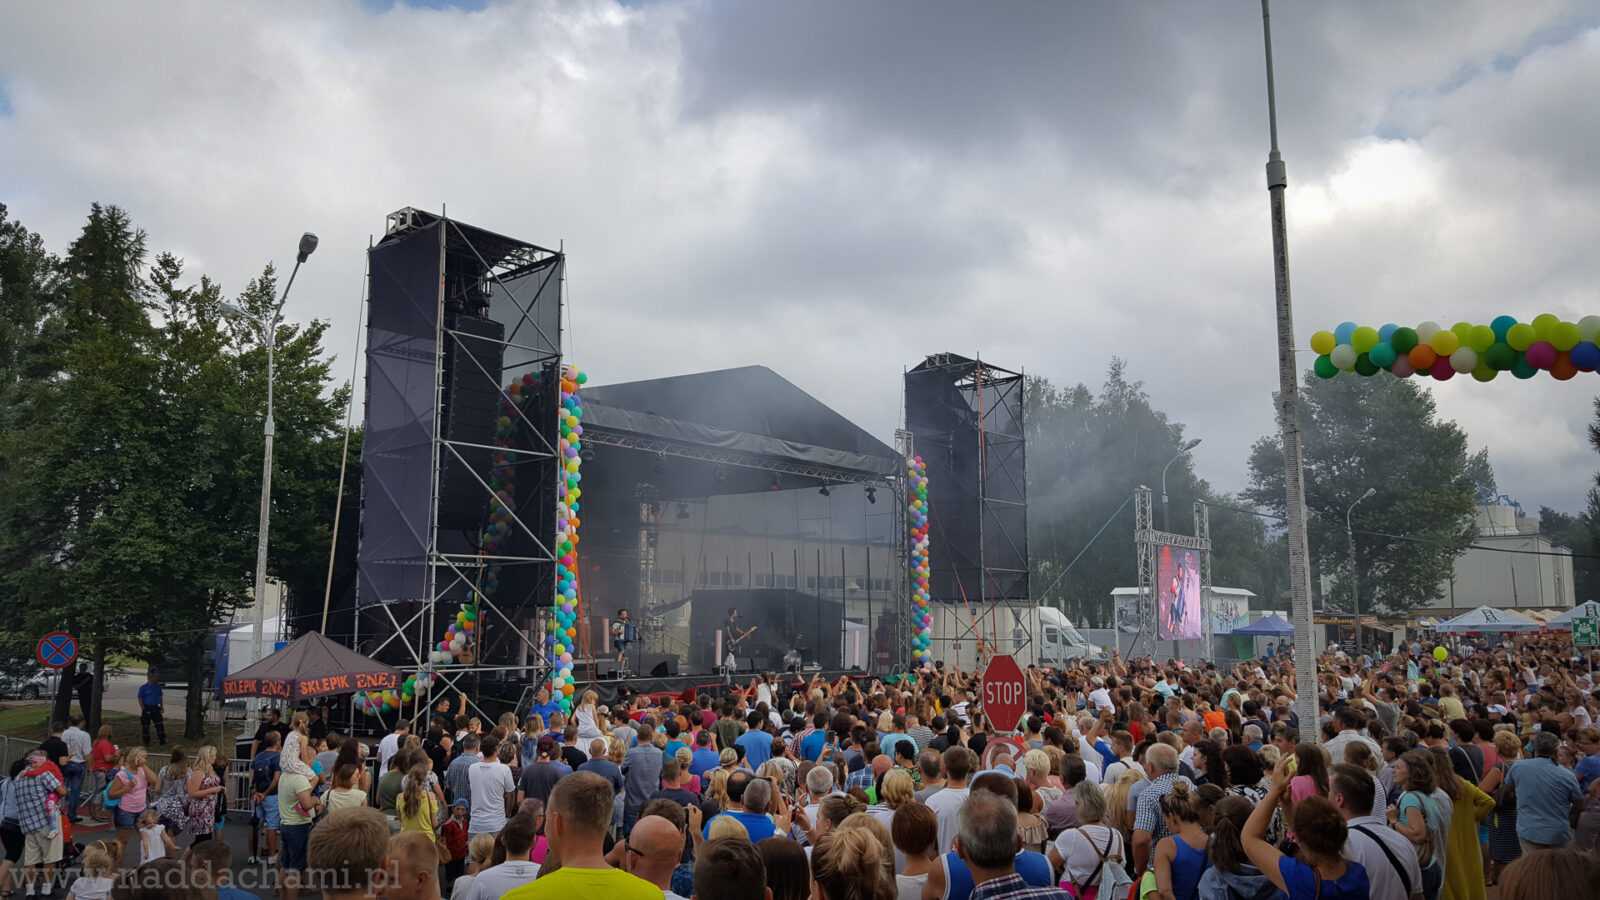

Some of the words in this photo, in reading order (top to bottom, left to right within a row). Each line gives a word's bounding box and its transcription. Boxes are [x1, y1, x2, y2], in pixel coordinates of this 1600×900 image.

[223, 679, 257, 695] SKLEPIK
[300, 675, 350, 695] SKLEPIK
[355, 672, 397, 689] ENEJ
[985, 681, 1023, 705] STOP
